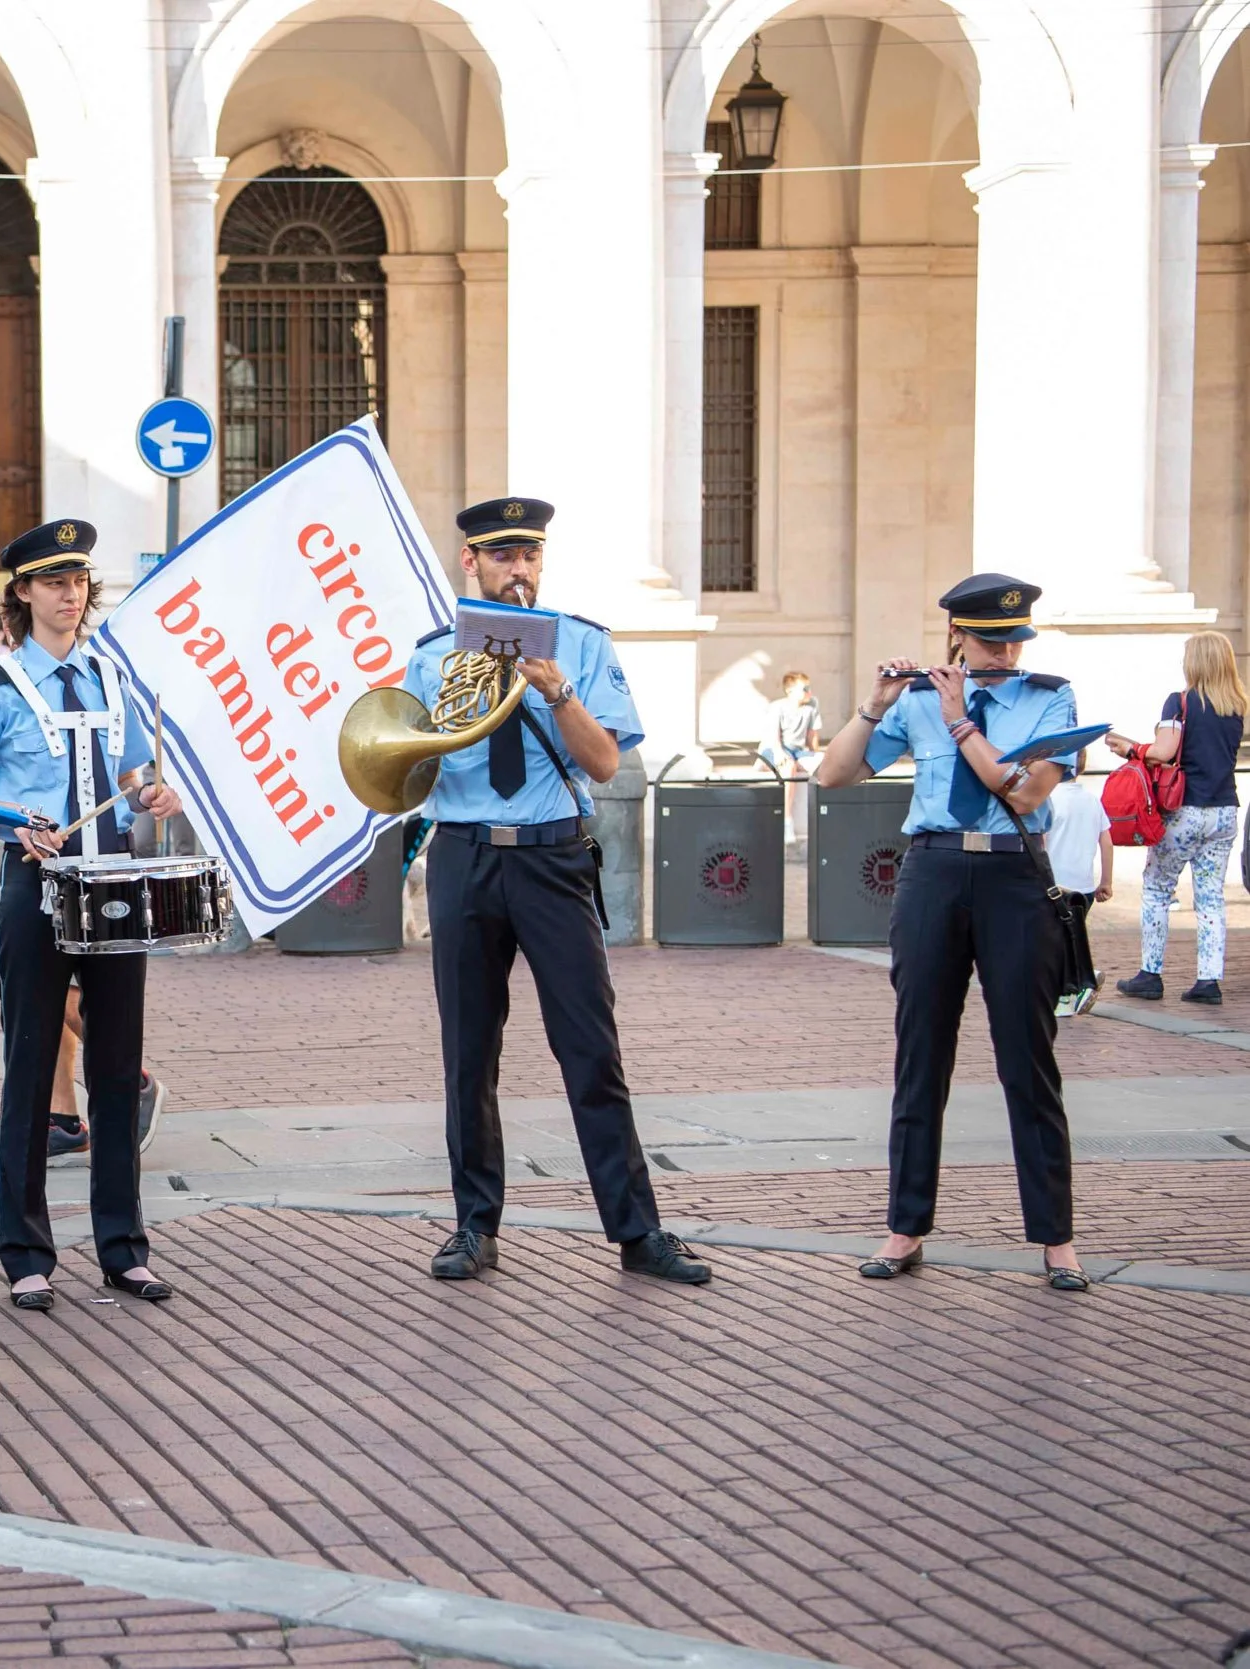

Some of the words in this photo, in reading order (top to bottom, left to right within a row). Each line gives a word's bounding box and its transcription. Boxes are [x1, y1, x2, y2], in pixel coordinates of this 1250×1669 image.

[266, 622, 340, 722] dei
[297, 523, 407, 690] circol
[154, 576, 336, 847] bambini
